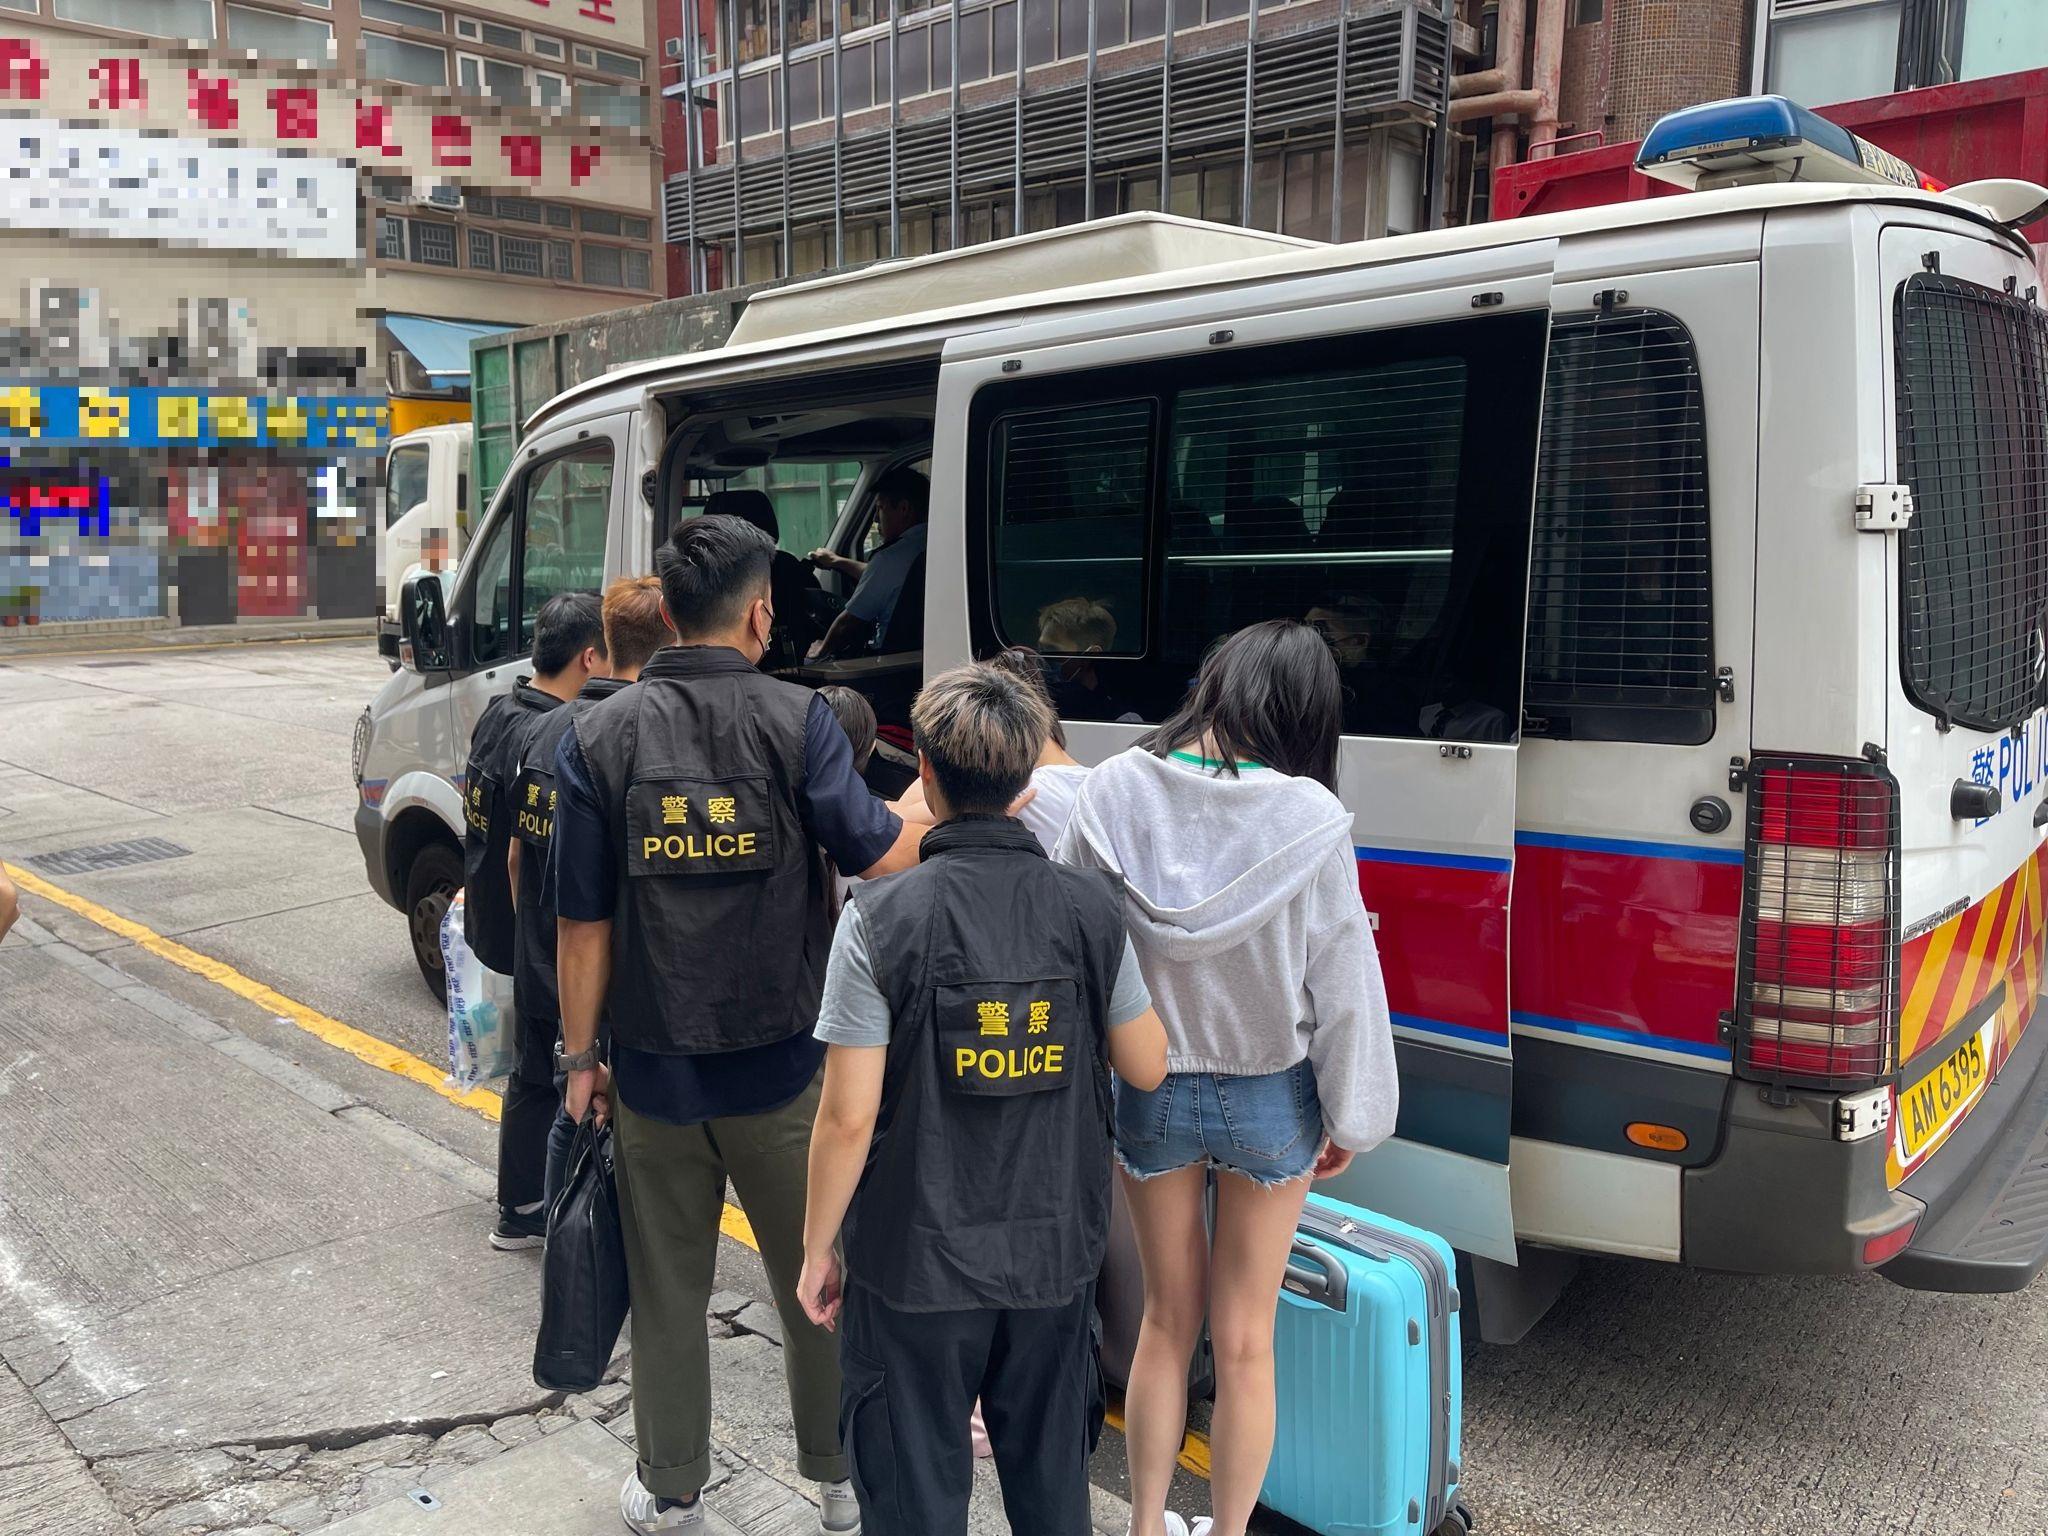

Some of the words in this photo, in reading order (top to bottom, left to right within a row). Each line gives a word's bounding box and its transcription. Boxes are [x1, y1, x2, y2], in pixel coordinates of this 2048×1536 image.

[661, 796, 736, 825] 警察
[643, 832, 756, 859] POLICE
[977, 1000, 1050, 1036] 警察
[956, 1045, 1064, 1079] POLICE
[1911, 1080, 1938, 1143] AM
[1940, 1034, 1981, 1111] 6395
